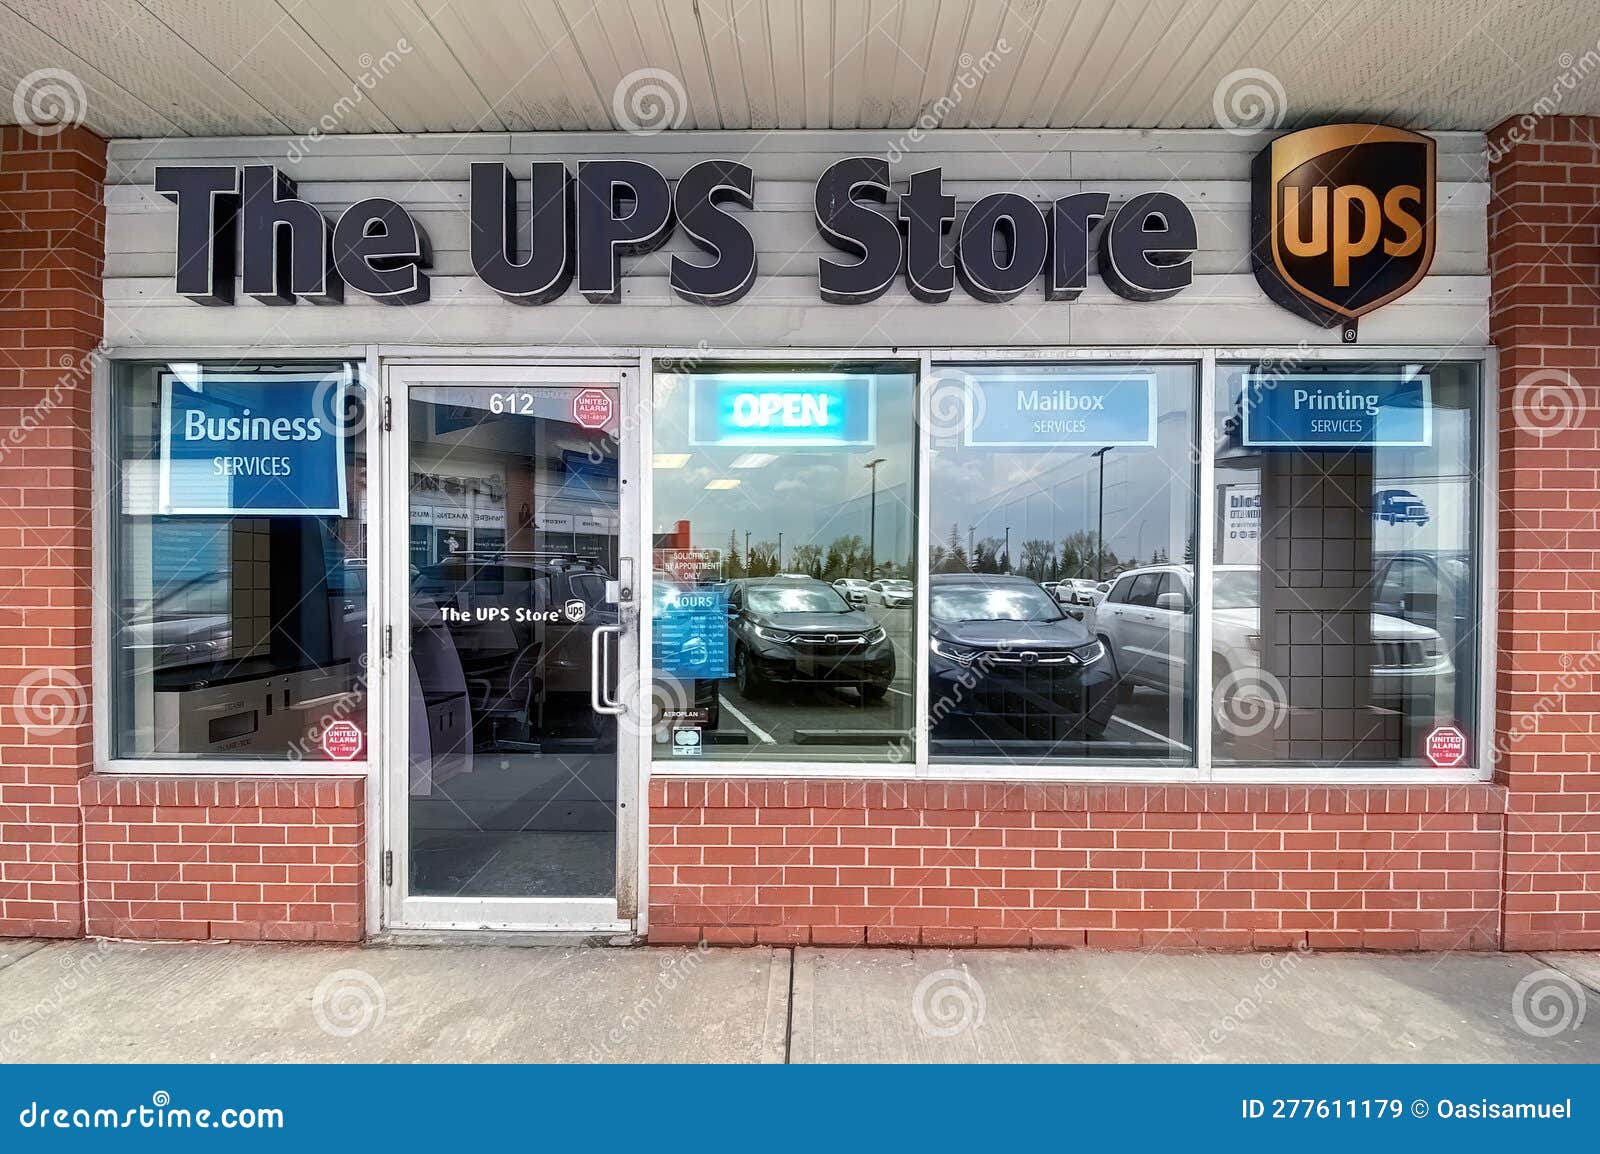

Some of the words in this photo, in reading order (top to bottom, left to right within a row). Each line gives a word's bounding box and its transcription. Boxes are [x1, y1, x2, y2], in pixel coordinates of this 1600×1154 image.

[154, 164, 431, 304] The
[470, 160, 757, 304] UPS
[814, 156, 1198, 303] Store
[1283, 184, 1423, 287] ups
[489, 392, 534, 415] 612
[733, 393, 829, 427] OPEN
[1016, 390, 1105, 411] Mailbox
[1294, 389, 1380, 416] Printing
[185, 408, 322, 441] Business
[1032, 420, 1087, 433] SERVICES
[1311, 420, 1362, 433] SERVICES
[213, 456, 291, 476] SERVICES
[440, 607, 471, 622] The
[476, 607, 510, 622] UPS
[515, 607, 559, 622] Store
[567, 605, 584, 617] ups
